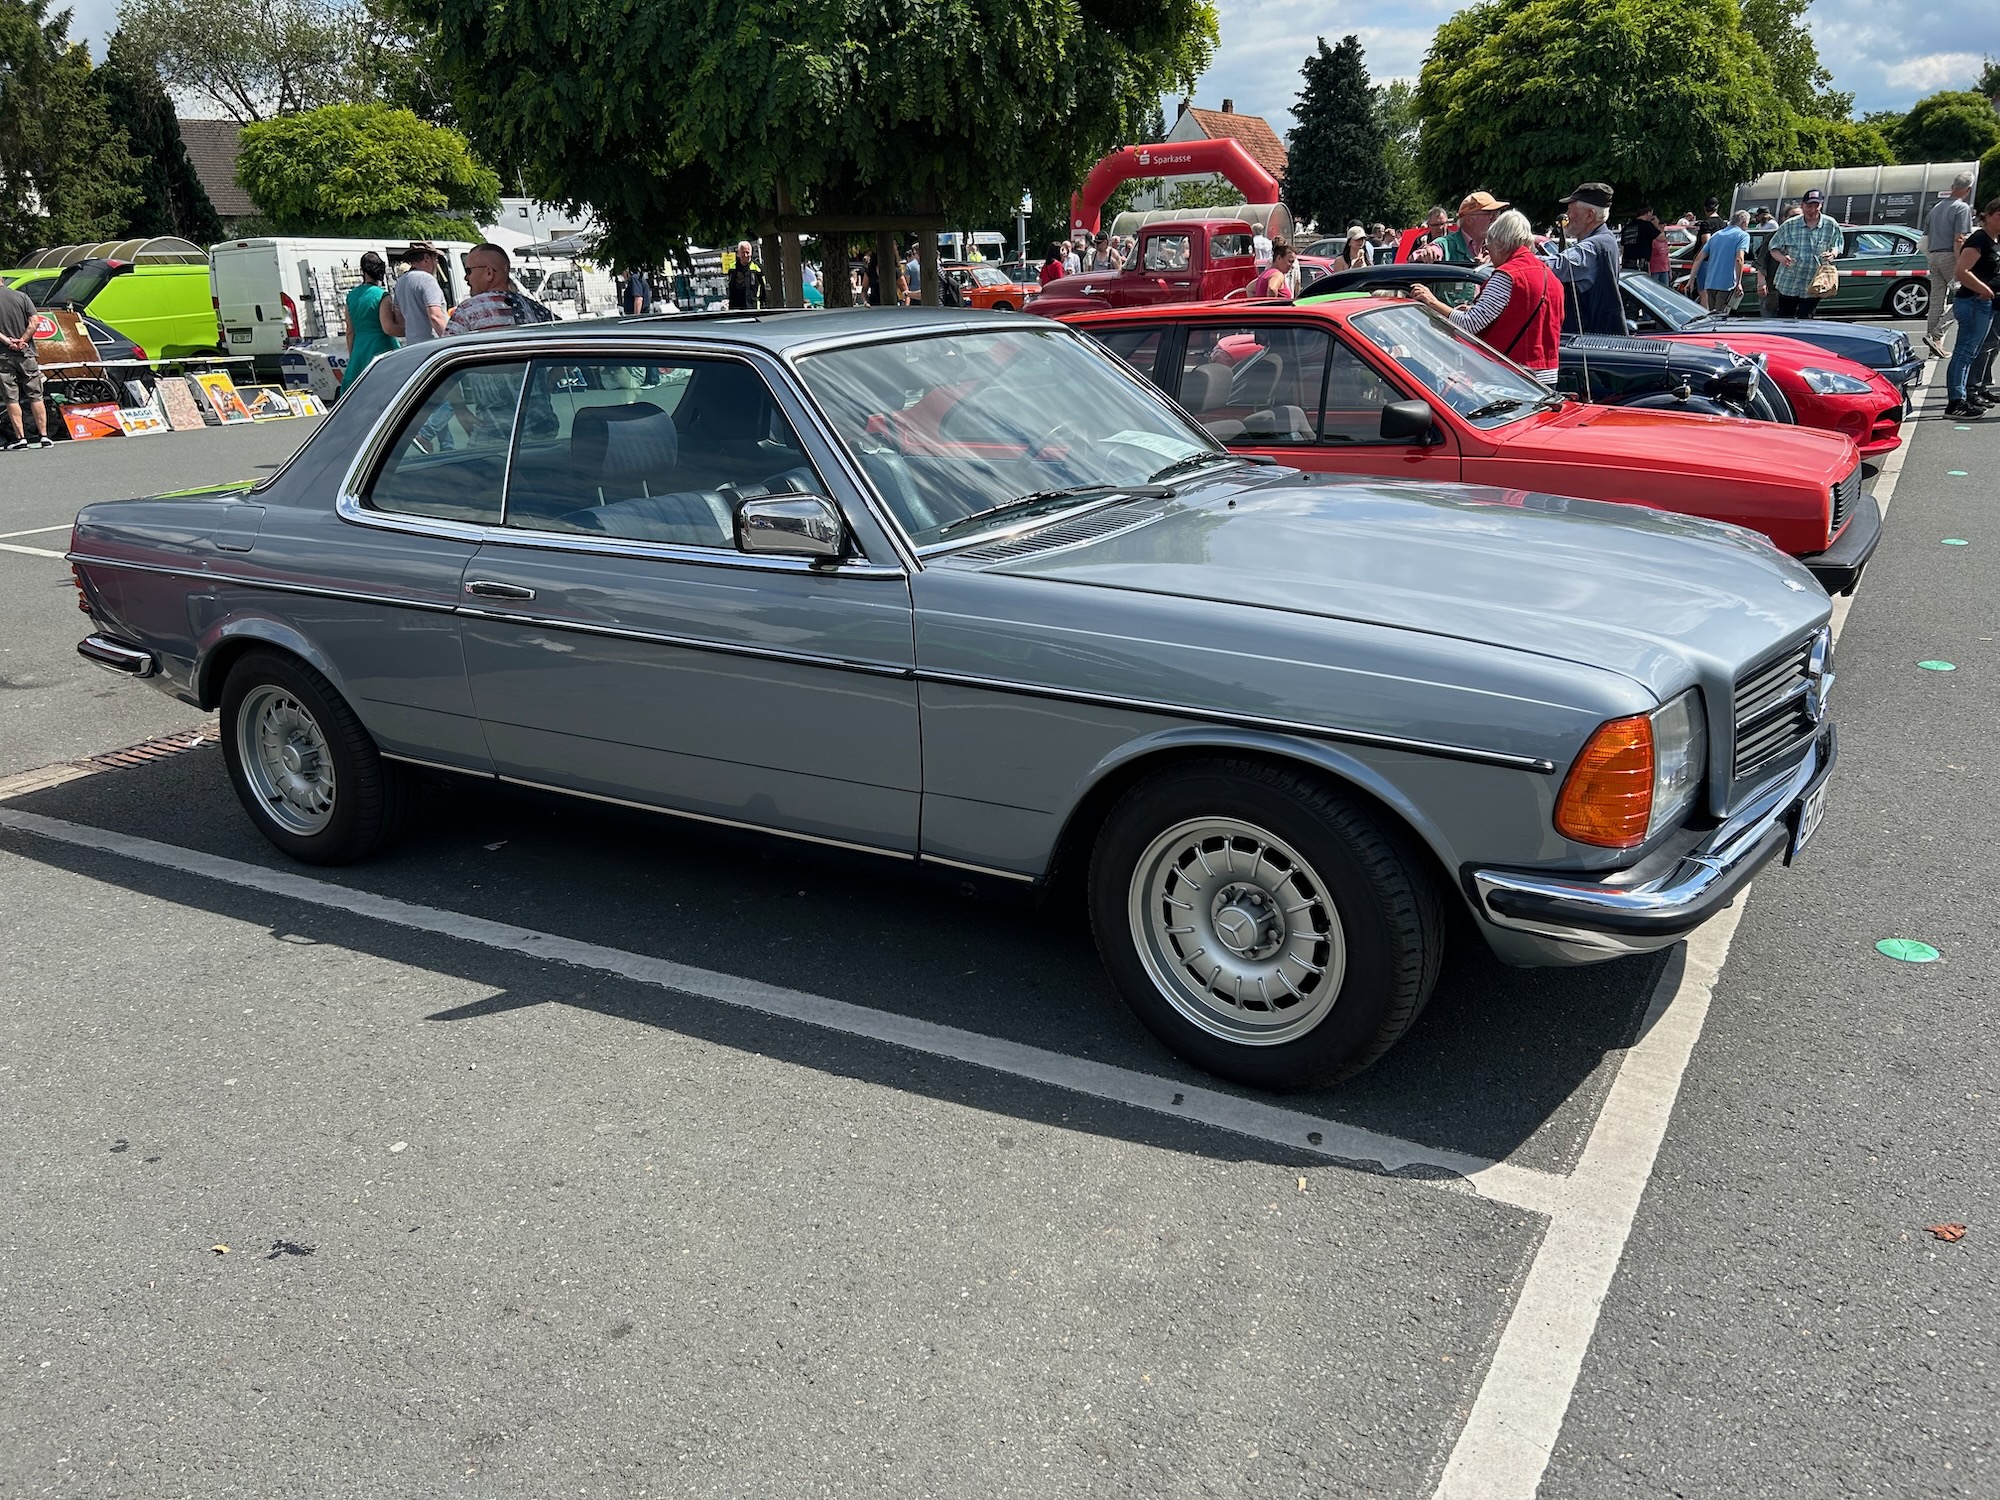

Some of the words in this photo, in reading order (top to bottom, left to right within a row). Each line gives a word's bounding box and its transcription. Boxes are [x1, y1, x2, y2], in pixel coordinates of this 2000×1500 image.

[1153, 155, 1192, 165] Sparkasse
[1843, 196, 1854, 225] ATSHOPPER
[1898, 244, 1909, 253] 62
[36, 319, 54, 332] sil
[327, 355, 349, 368] Be
[124, 409, 153, 418] MAGGI
